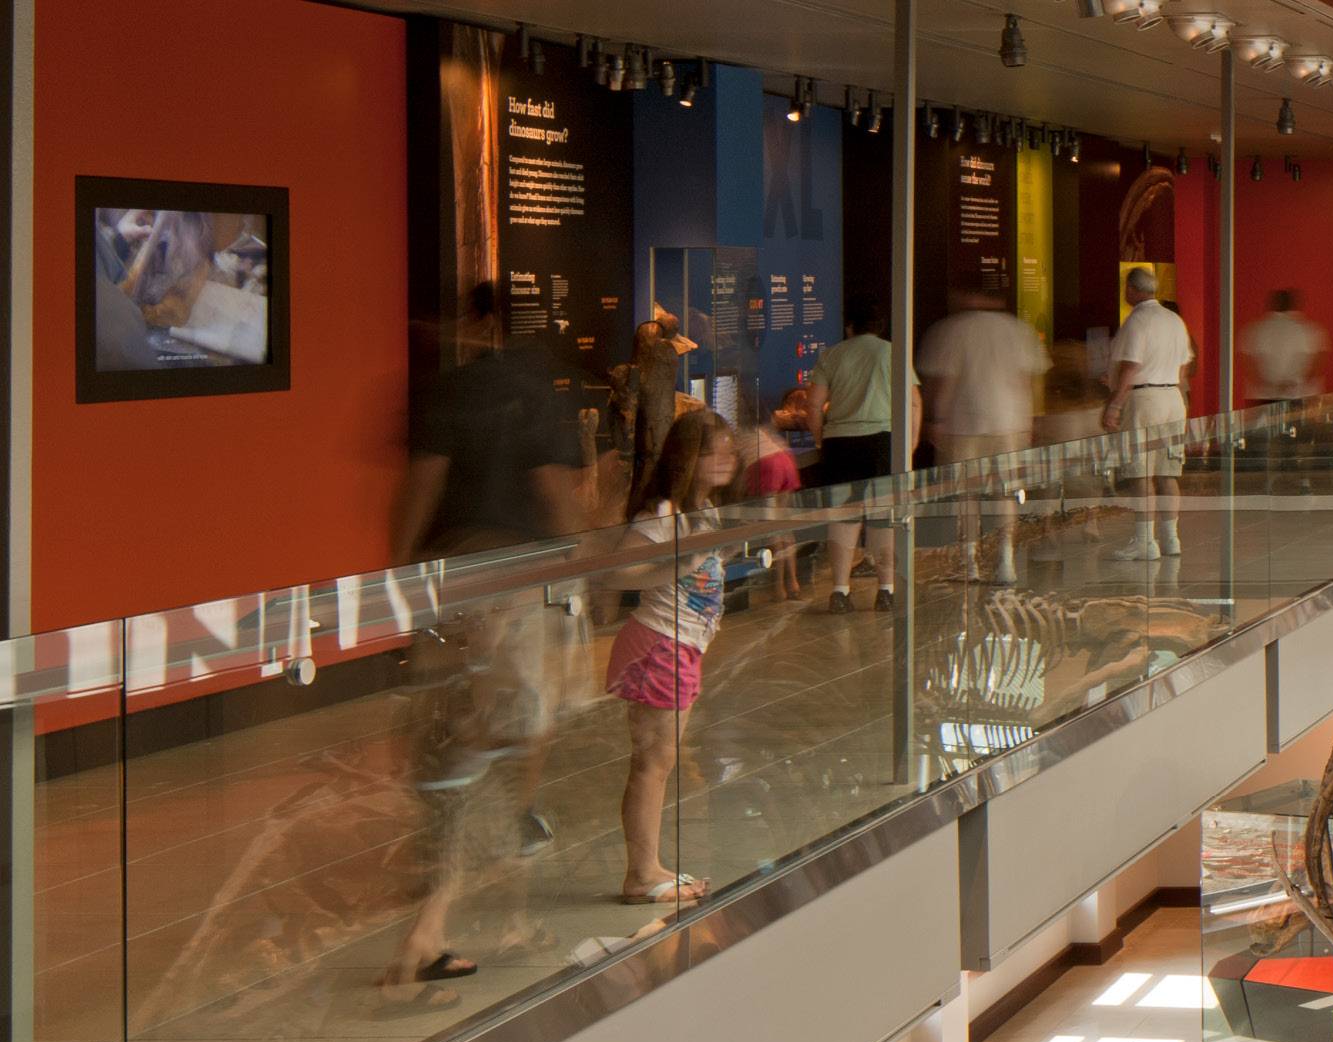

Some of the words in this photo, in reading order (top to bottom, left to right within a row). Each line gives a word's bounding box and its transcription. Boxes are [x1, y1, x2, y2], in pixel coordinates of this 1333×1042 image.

[508, 96, 527, 115] How
[528, 98, 541, 117] fast
[542, 102, 555, 119] did
[509, 119, 545, 140] dinosaurs
[546, 128, 569, 145] grow?
